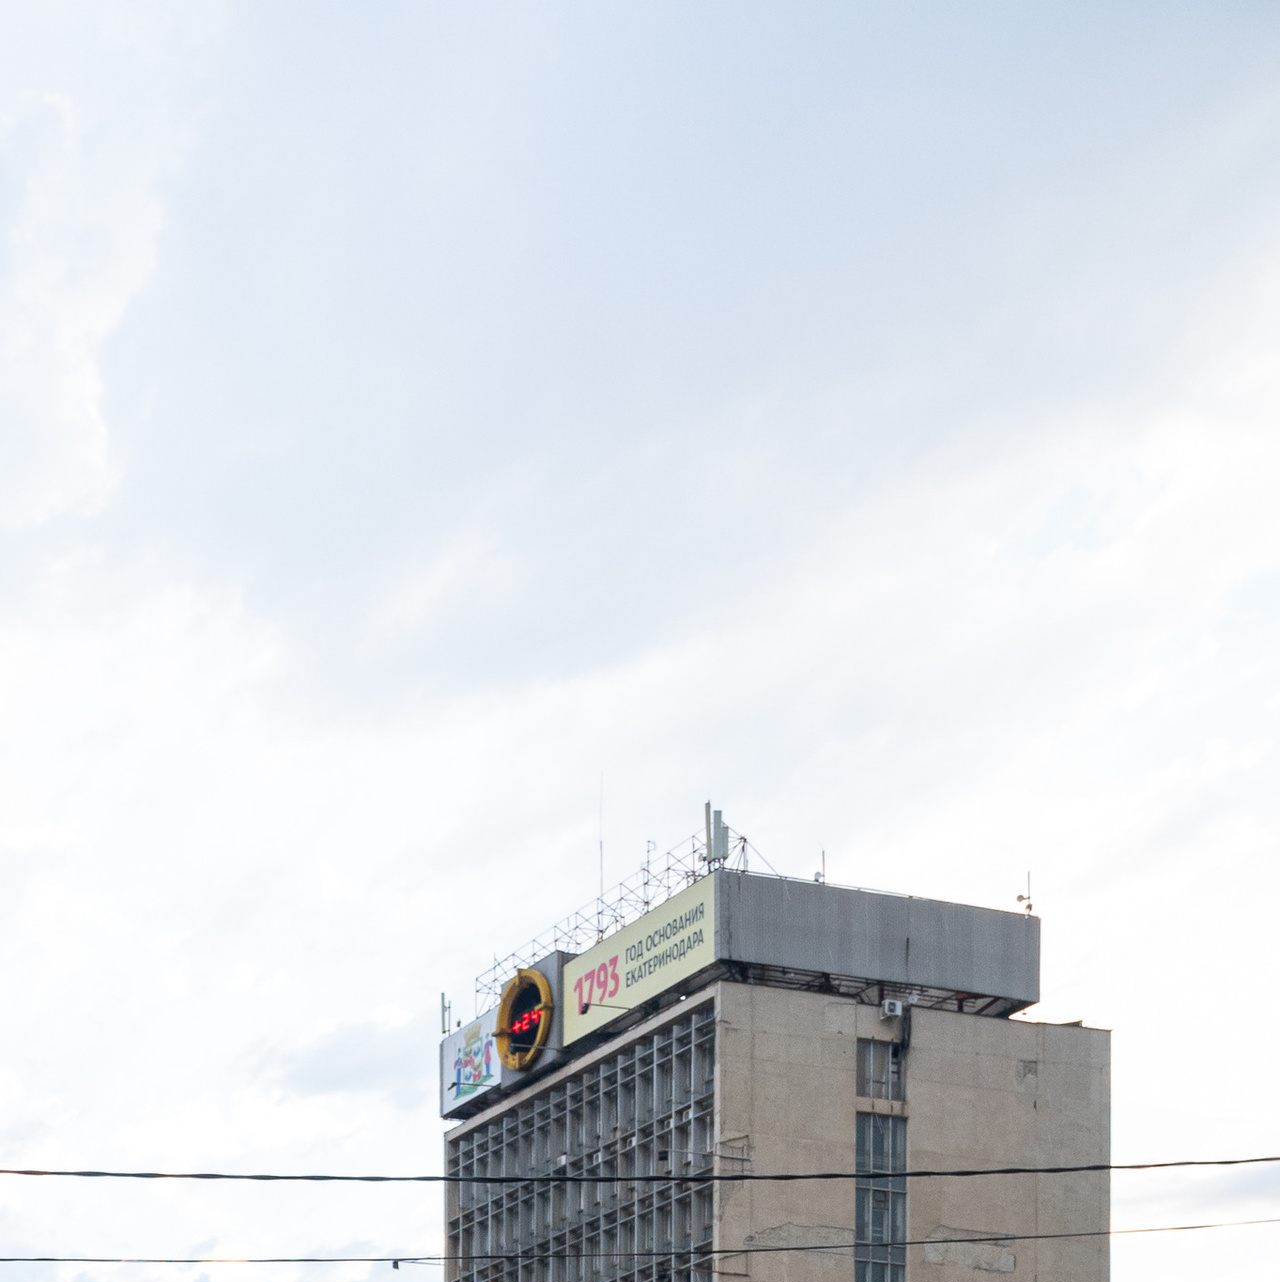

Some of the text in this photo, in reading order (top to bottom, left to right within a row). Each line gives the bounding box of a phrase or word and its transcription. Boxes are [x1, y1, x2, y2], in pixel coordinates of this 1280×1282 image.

[625, 902, 705, 965] ГОД ОСНОВАНИЯ
[625, 929, 704, 988] ЕКАТЕРИНОДАРА
[573, 954, 620, 1016] 1793
